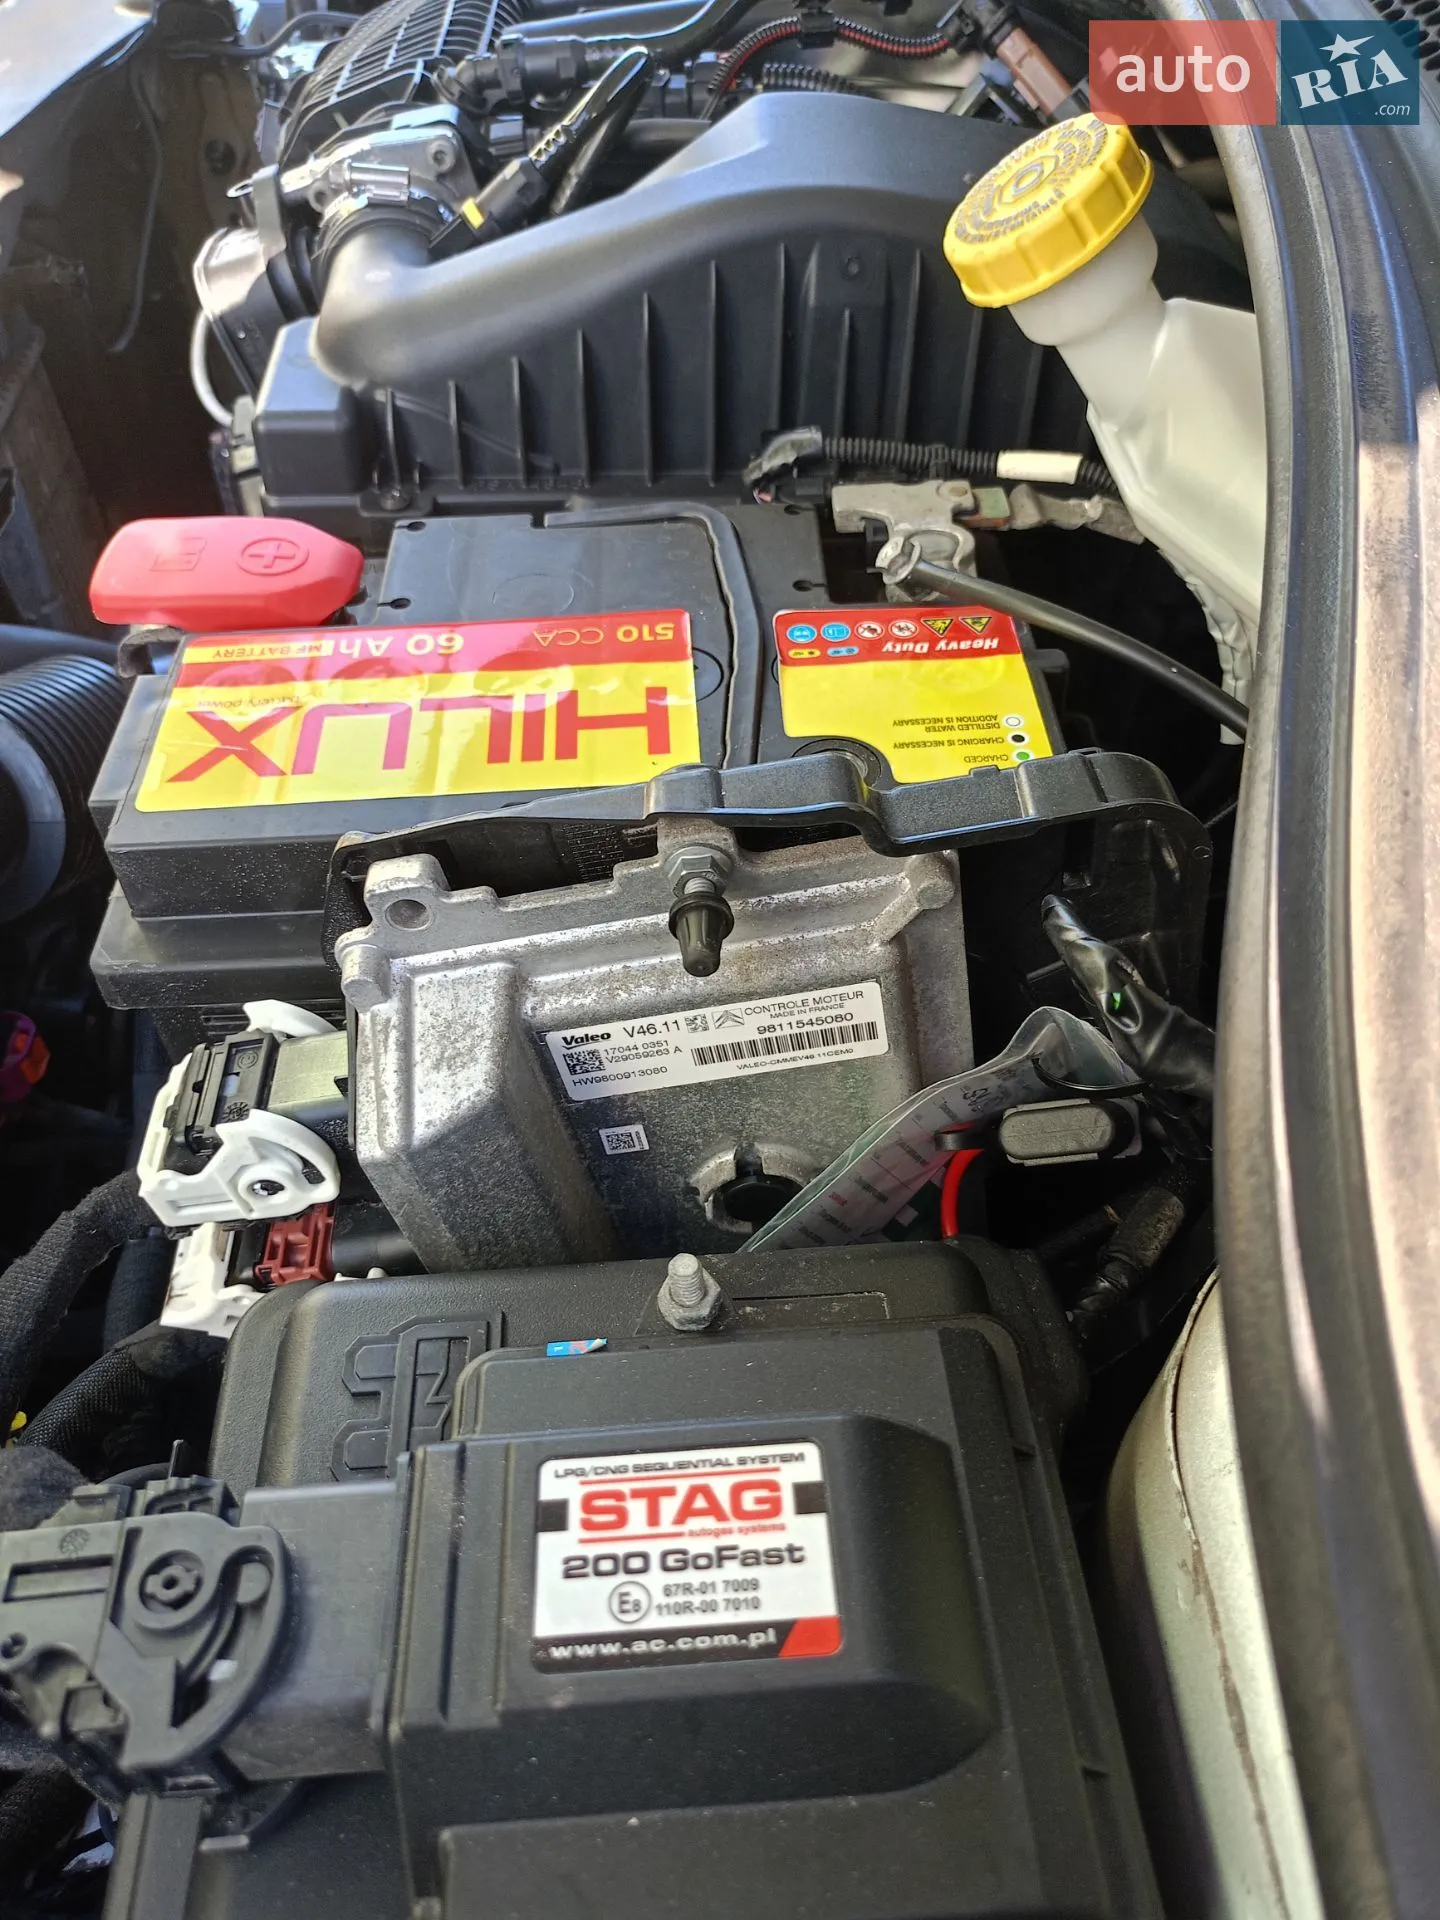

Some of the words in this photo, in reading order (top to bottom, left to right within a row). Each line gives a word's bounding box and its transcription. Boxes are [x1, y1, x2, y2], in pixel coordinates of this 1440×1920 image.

[533, 626, 604, 648] CCA
[616, 622, 675, 643] 510
[212, 645, 290, 659] BATTERY
[337, 635, 394, 660] Ah
[406, 632, 464, 656] 60
[882, 641, 930, 654] Duty
[935, 637, 999, 650] Heavy
[892, 716, 944, 727] NECESSARY
[925, 724, 956, 733] WATER
[945, 716, 954, 724] IS
[955, 714, 998, 724] ADDITION
[957, 722, 1001, 731] DISTILLED
[166, 686, 671, 783] HILUX
[947, 739, 956, 747] IS
[957, 737, 1005, 746] CHARGING
[893, 739, 945, 750] NECESSARY
[963, 753, 1009, 764] CHARGED
[744, 998, 810, 1016] CONTROLE
[812, 990, 864, 1006] MOTEUR
[770, 1010, 796, 1019] MADE
[797, 1008, 808, 1016] IN
[808, 1002, 845, 1013] FRANCE
[561, 1031, 612, 1047] Valeo
[623, 1019, 681, 1039] V46.11
[756, 1012, 854, 1035] 9811545080
[604, 1043, 639, 1056] 17044
[641, 1039, 669, 1050] 0351
[605, 1047, 670, 1064] V29059263
[673, 1045, 683, 1054] A
[572, 1065, 668, 1087] HW9800913080
[554, 1463, 629, 1479] LPG/CNG
[632, 1456, 734, 1474] SEQUENTIAL
[736, 1451, 806, 1466] SYSTEM
[579, 1479, 783, 1532] STAG
[687, 1525, 734, 1539] autogas
[737, 1522, 787, 1536] systems
[562, 1550, 651, 1580] 200
[659, 1542, 805, 1574] GoFast
[662, 1580, 717, 1598] 67R-01
[721, 1577, 760, 1594] 7009
[655, 1598, 719, 1616] 110R-00
[723, 1595, 761, 1612] 7010
[550, 1627, 777, 1660] www.ac.com.pl
